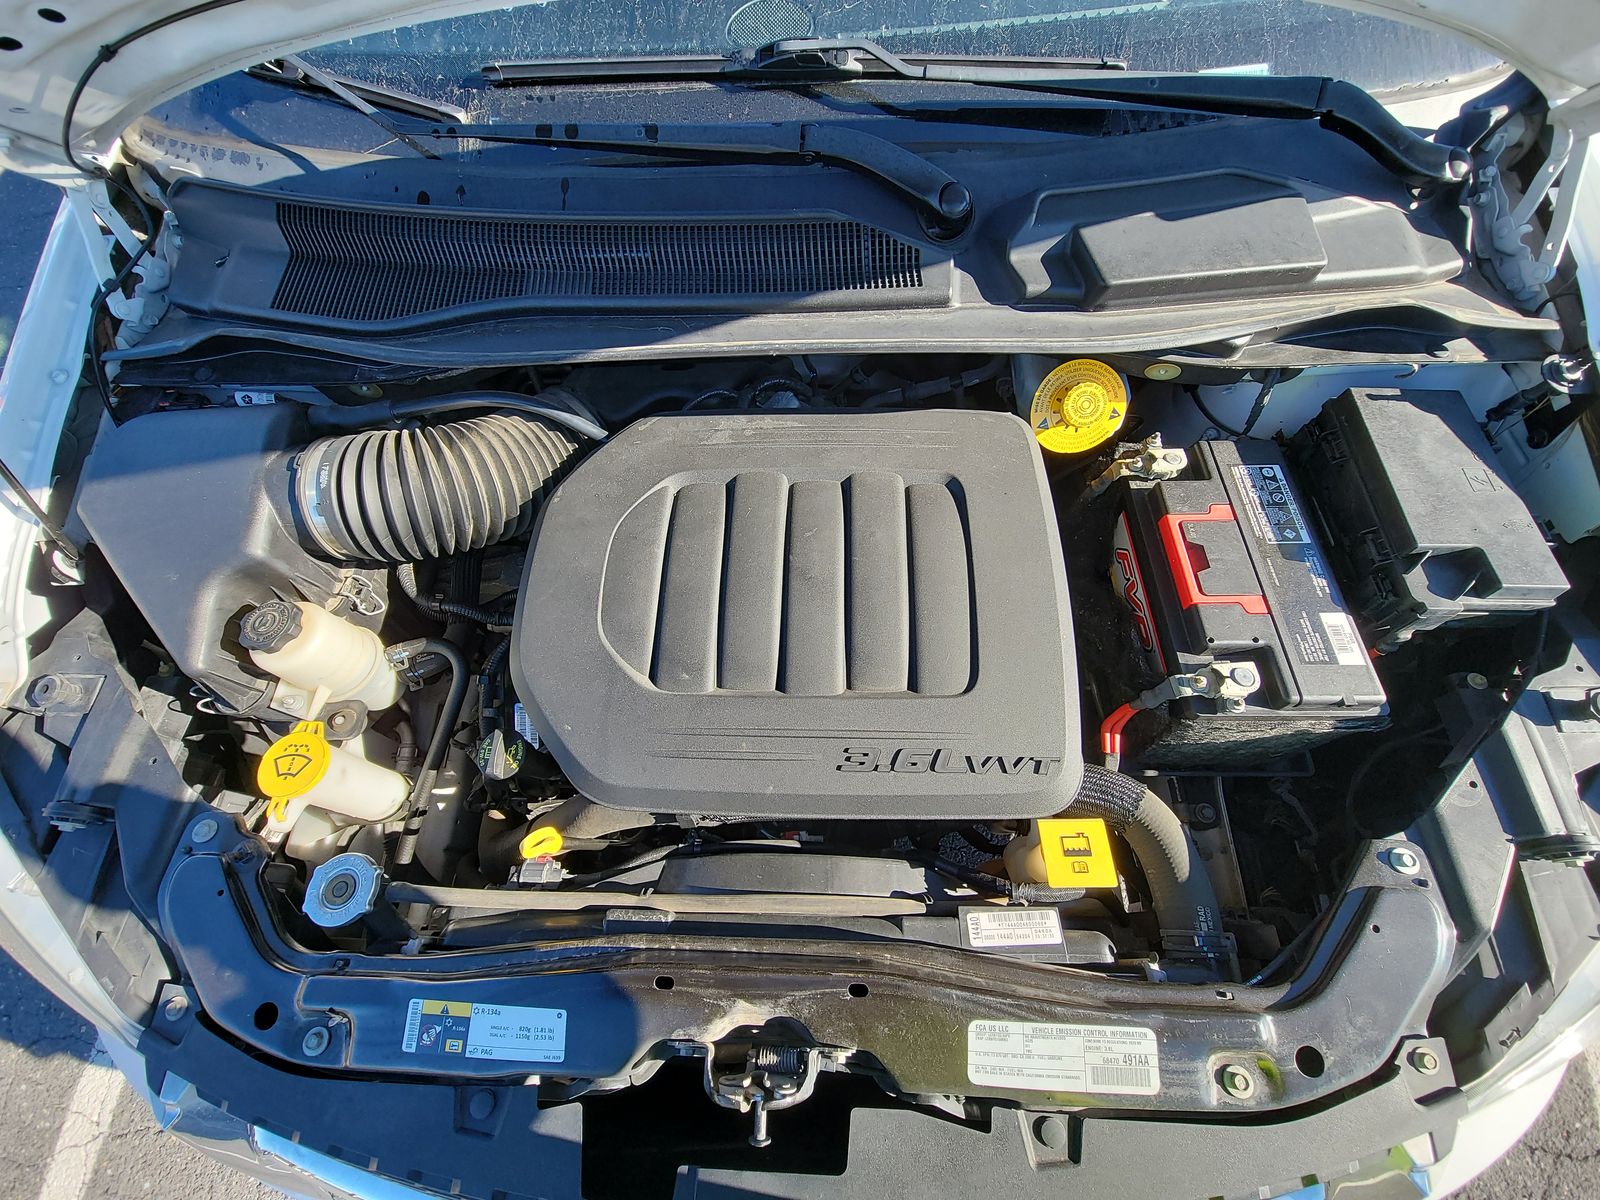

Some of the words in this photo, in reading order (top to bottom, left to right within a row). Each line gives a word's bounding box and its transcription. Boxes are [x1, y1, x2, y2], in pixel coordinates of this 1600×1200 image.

[1115, 548, 1154, 653] FVP
[836, 747, 967, 774] 3.6L
[964, 756, 1060, 776] VVT
[1197, 906, 1206, 921] RAD
[1083, 1029, 1108, 1037] CONTROL
[1110, 1030, 1148, 1038] INFORMATION
[1123, 1054, 1150, 1066] 491AA
